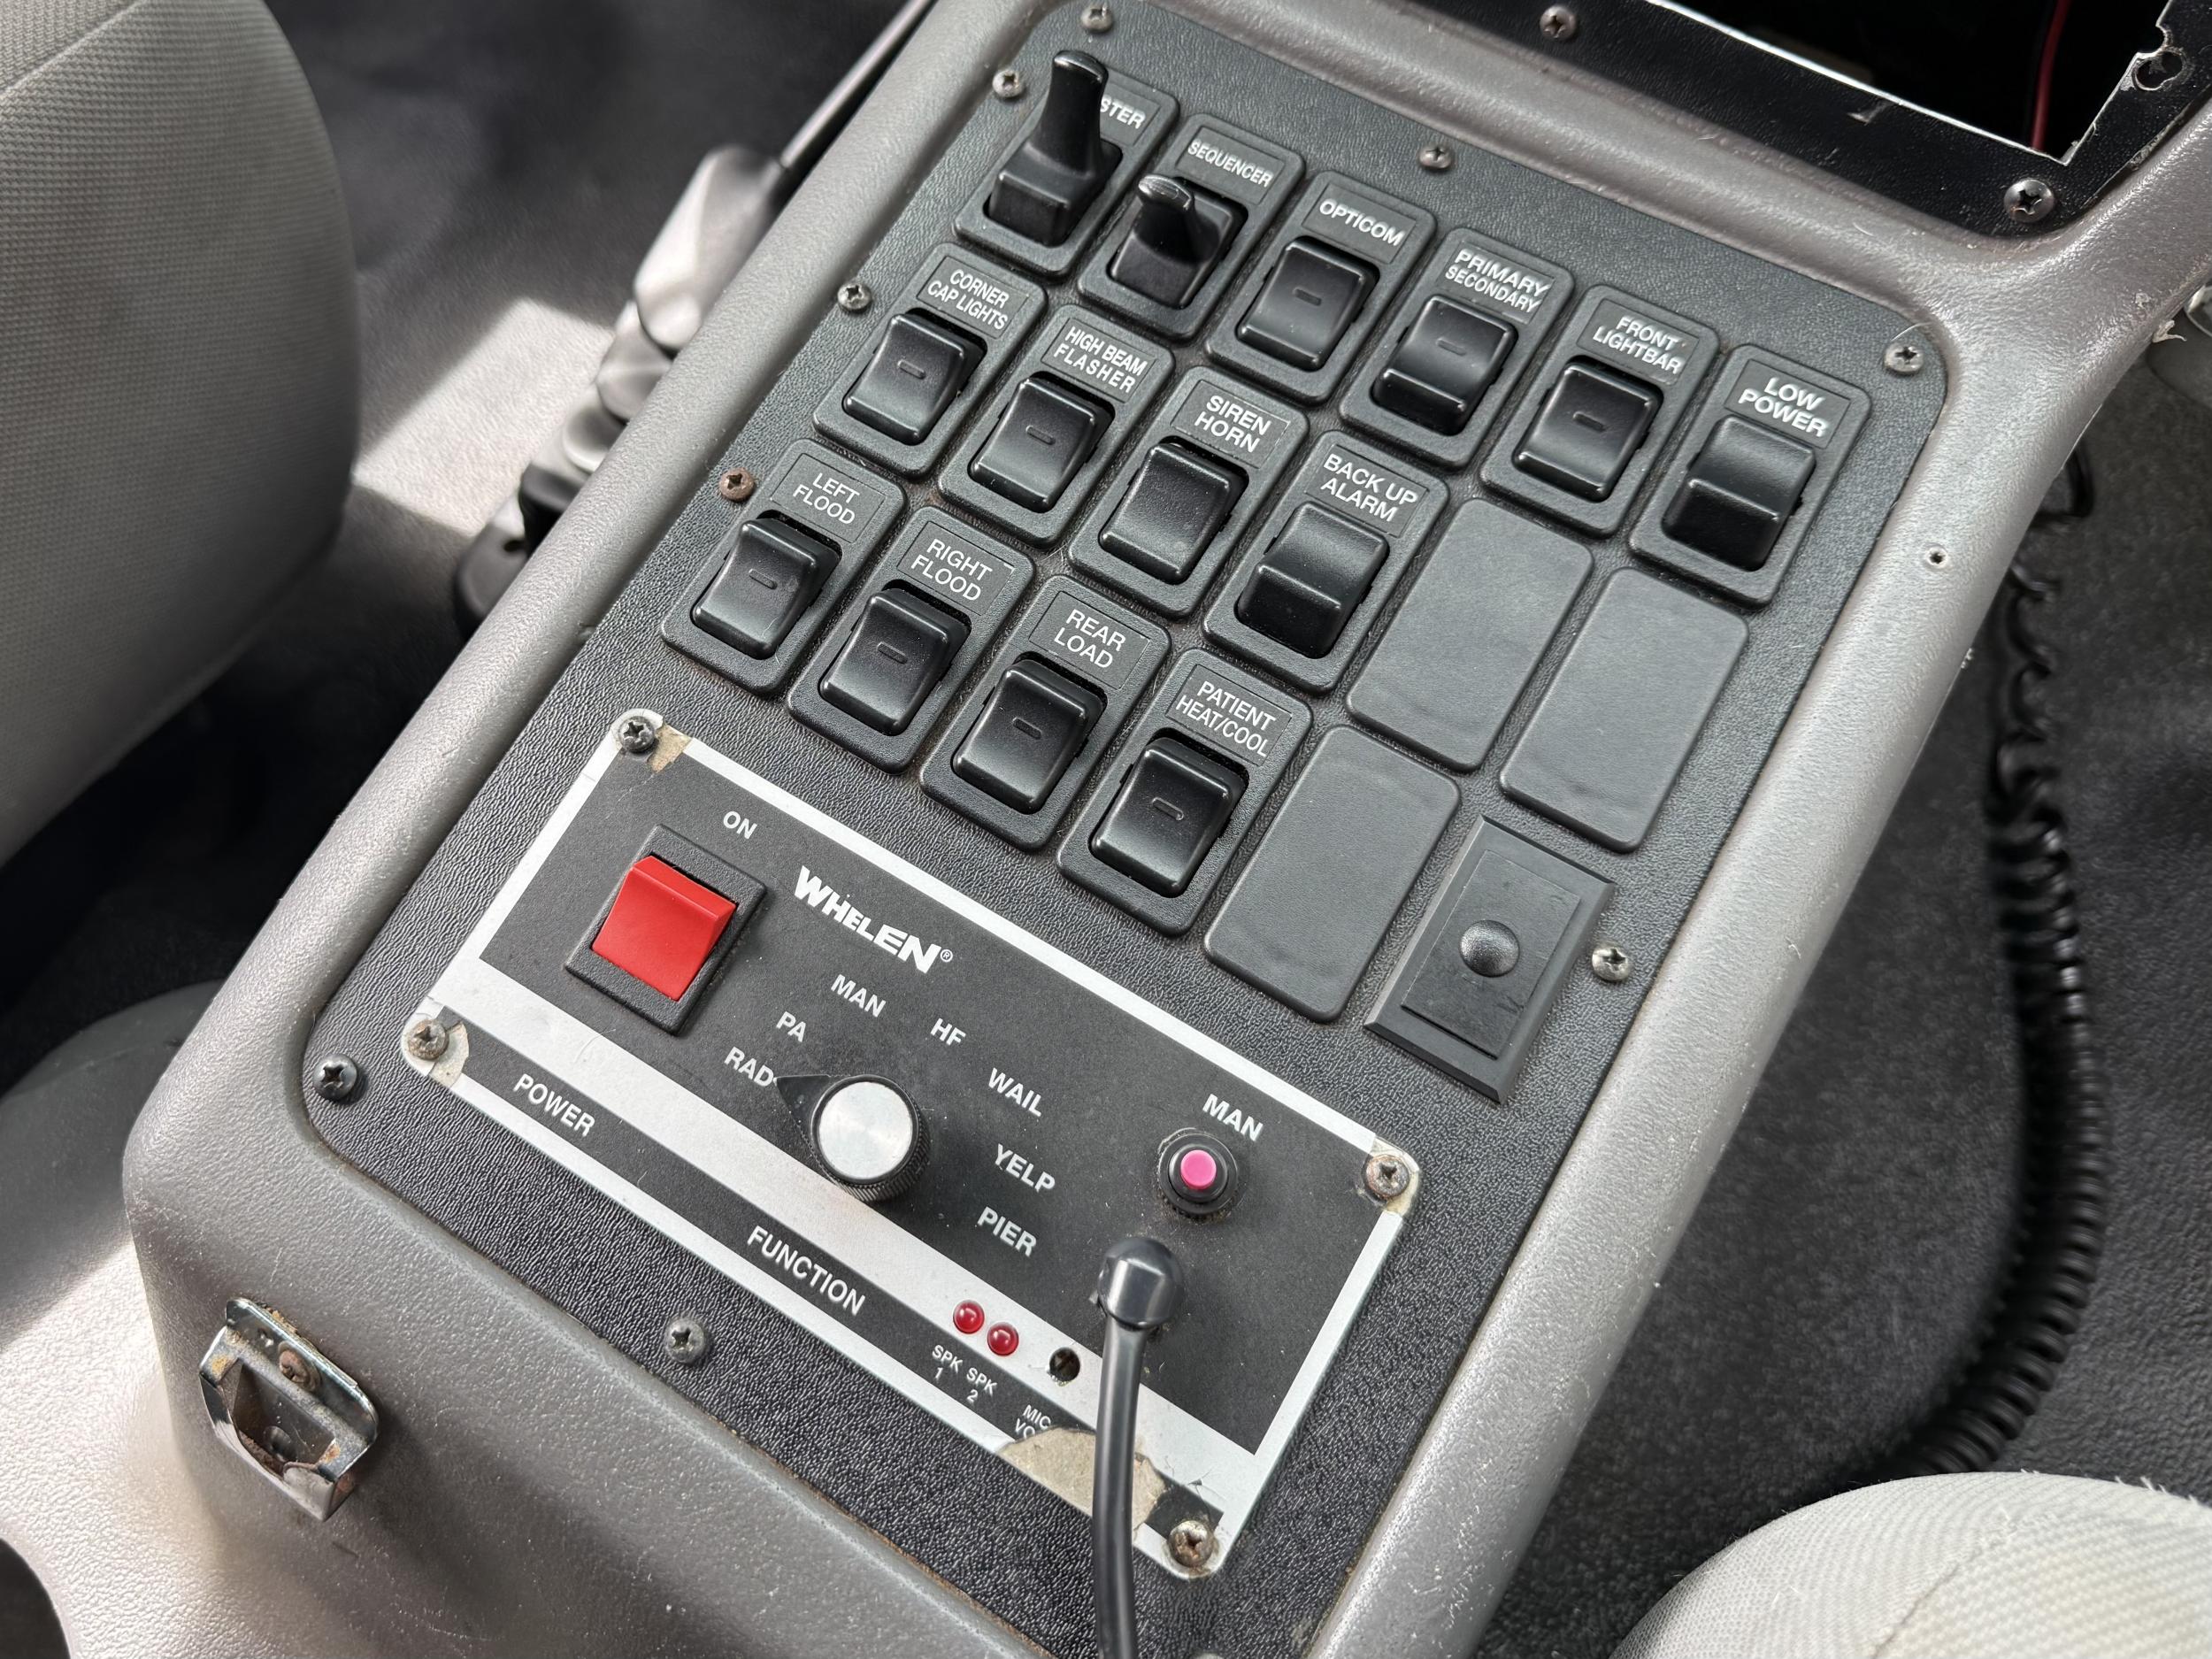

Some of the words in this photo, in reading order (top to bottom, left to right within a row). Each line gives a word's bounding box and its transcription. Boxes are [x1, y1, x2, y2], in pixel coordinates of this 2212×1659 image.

[1100, 94, 1146, 129] STER
[1187, 138, 1274, 188] SEQUENCER
[1319, 200, 1405, 247] OPTICOM
[950, 269, 1010, 309] CORNER
[1445, 265, 1543, 312] SECONDARY
[1455, 248, 1552, 297] PRIMARY
[927, 280, 959, 303] CAP
[956, 295, 1008, 330] LIGHTS
[1064, 326, 1104, 354] HIGH
[1102, 344, 1148, 376] BEAM
[1593, 326, 1684, 375] LIGHTBAR
[1615, 316, 1678, 349] FRONT
[1054, 343, 1136, 393] FLASHER
[1739, 388, 1829, 438] POWER
[1763, 377, 1824, 410] LOW
[1194, 411, 1260, 453] HORN
[1206, 396, 1271, 435] SIREN
[812, 472, 860, 503] LEFT
[1320, 476, 1400, 523] ALARM
[1323, 453, 1386, 494] BACK
[1386, 480, 1417, 507] UP
[793, 484, 856, 525] FLOOD
[910, 554, 981, 602] FLOOD
[926, 539, 993, 581] RIGHT
[1054, 628, 1113, 669] LOAD
[1065, 609, 1126, 652] REAR
[1175, 695, 1269, 757] HEAT/COOL
[1197, 680, 1276, 732] PATIENT
[723, 810, 757, 839] ON
[831, 974, 886, 1018] MAN
[776, 1011, 806, 1041] PA
[930, 1018, 966, 1046] HF
[724, 1046, 774, 1087] RAD
[513, 1073, 595, 1137] POWER
[988, 1067, 1043, 1118] WAIL
[1202, 1094, 1263, 1141] MAN
[995, 1144, 1056, 1194] YELP
[977, 1206, 1037, 1257] PIER
[747, 1225, 866, 1317] FUNCTION
[932, 1344, 963, 1373] SPK
[934, 1367, 943, 1382] 1
[966, 1367, 997, 1396] SPK
[966, 1388, 979, 1404] 2
[1015, 1417, 1035, 1440] VO
[1023, 1404, 1051, 1430] MIC
